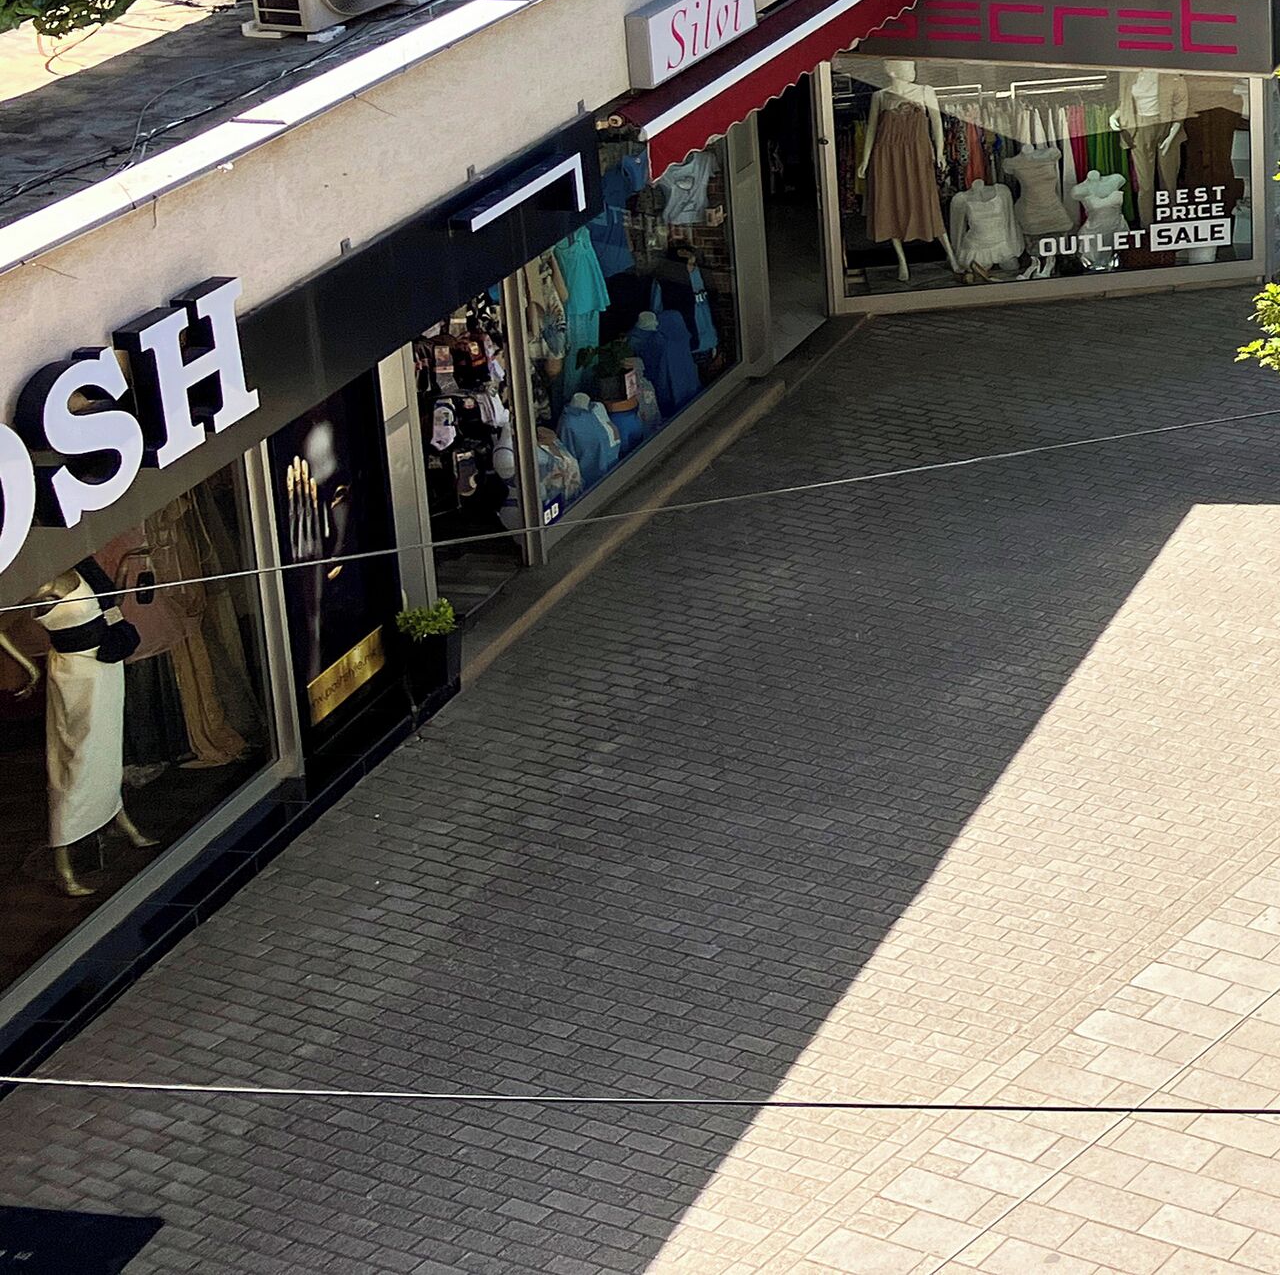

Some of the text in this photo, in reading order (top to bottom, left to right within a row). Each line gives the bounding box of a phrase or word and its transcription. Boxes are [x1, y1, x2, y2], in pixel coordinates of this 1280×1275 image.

[1156, 186, 1226, 205] BEST
[1156, 203, 1225, 221] PRICE
[1039, 223, 1225, 257] OUTLET SALE
